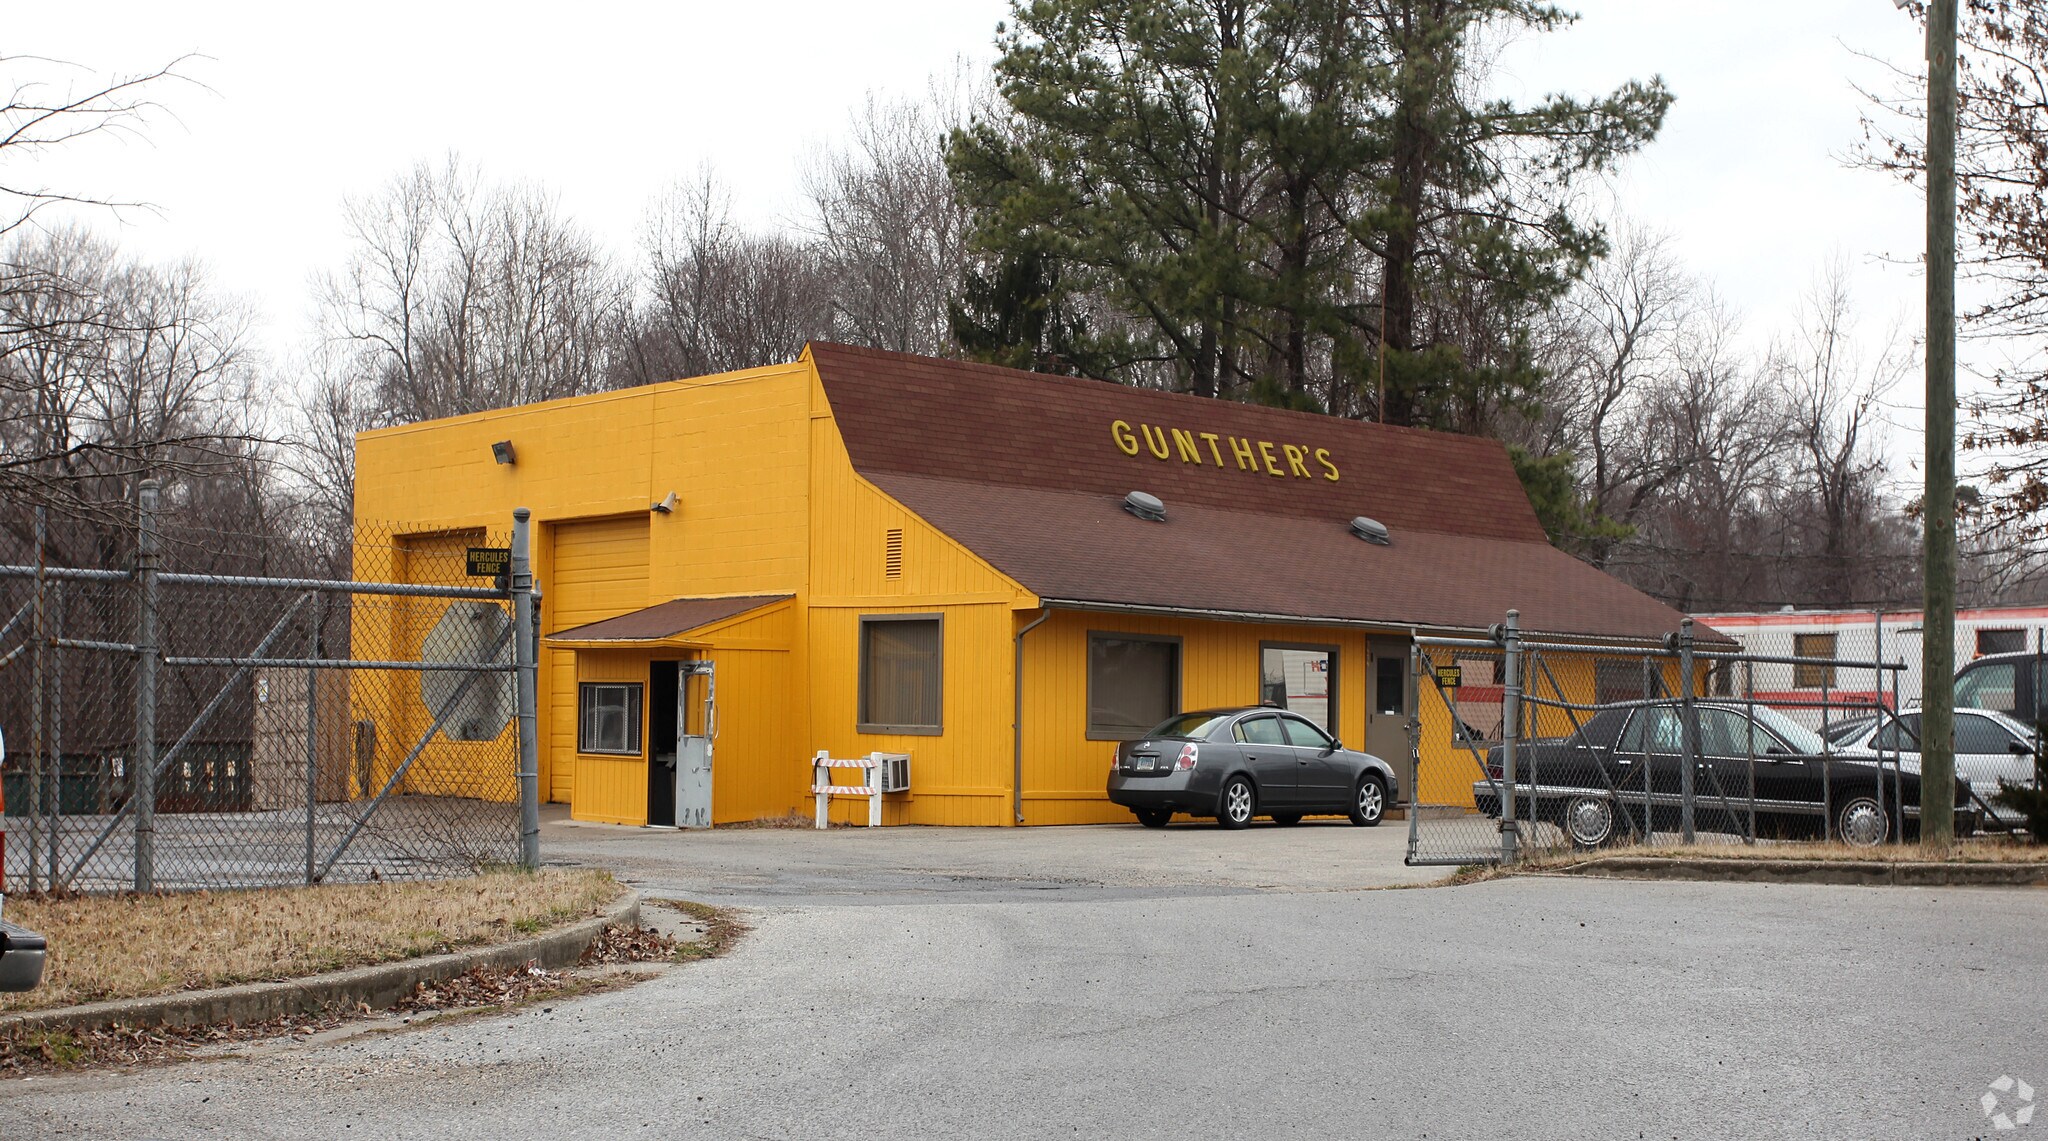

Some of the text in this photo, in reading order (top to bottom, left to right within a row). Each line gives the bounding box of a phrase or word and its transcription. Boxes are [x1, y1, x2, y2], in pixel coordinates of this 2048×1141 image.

[1111, 419, 1340, 481] GUNTHER'S
[470, 551, 509, 562] HERCULES
[476, 562, 500, 573] FENCE
[1437, 668, 1460, 677] HERCULES
[1441, 677, 1456, 685] FENCE
